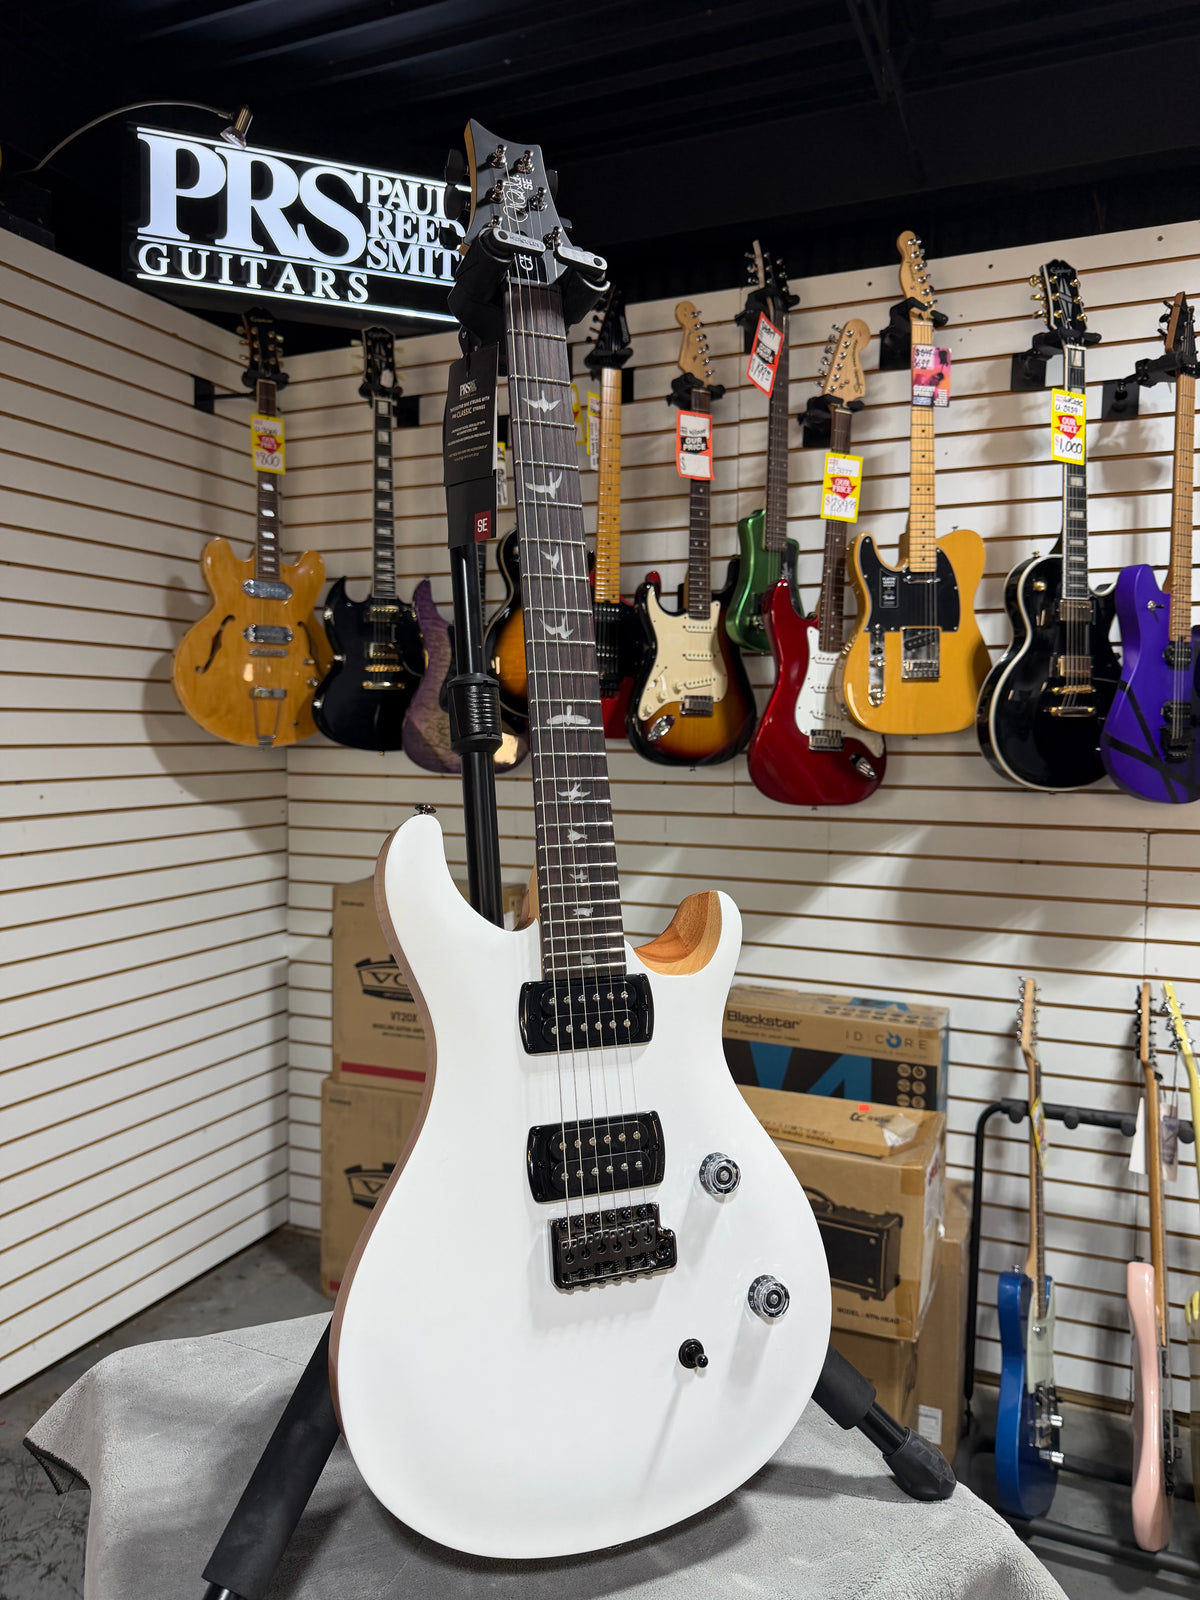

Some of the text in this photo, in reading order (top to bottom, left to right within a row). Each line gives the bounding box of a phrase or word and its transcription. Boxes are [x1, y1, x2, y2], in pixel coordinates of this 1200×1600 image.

[137, 133, 367, 265] PRS
[367, 237, 462, 281] SMIT
[138, 243, 369, 303] GUITARS
[1061, 416, 1077, 426] OUR
[1059, 424, 1079, 434] PRICE
[685, 437, 703, 445] OUR
[683, 443, 707, 452] PRICE
[832, 485, 853, 494] PRICE
[477, 518, 488, 532] SE
[727, 1010, 801, 1029] Blackstar
